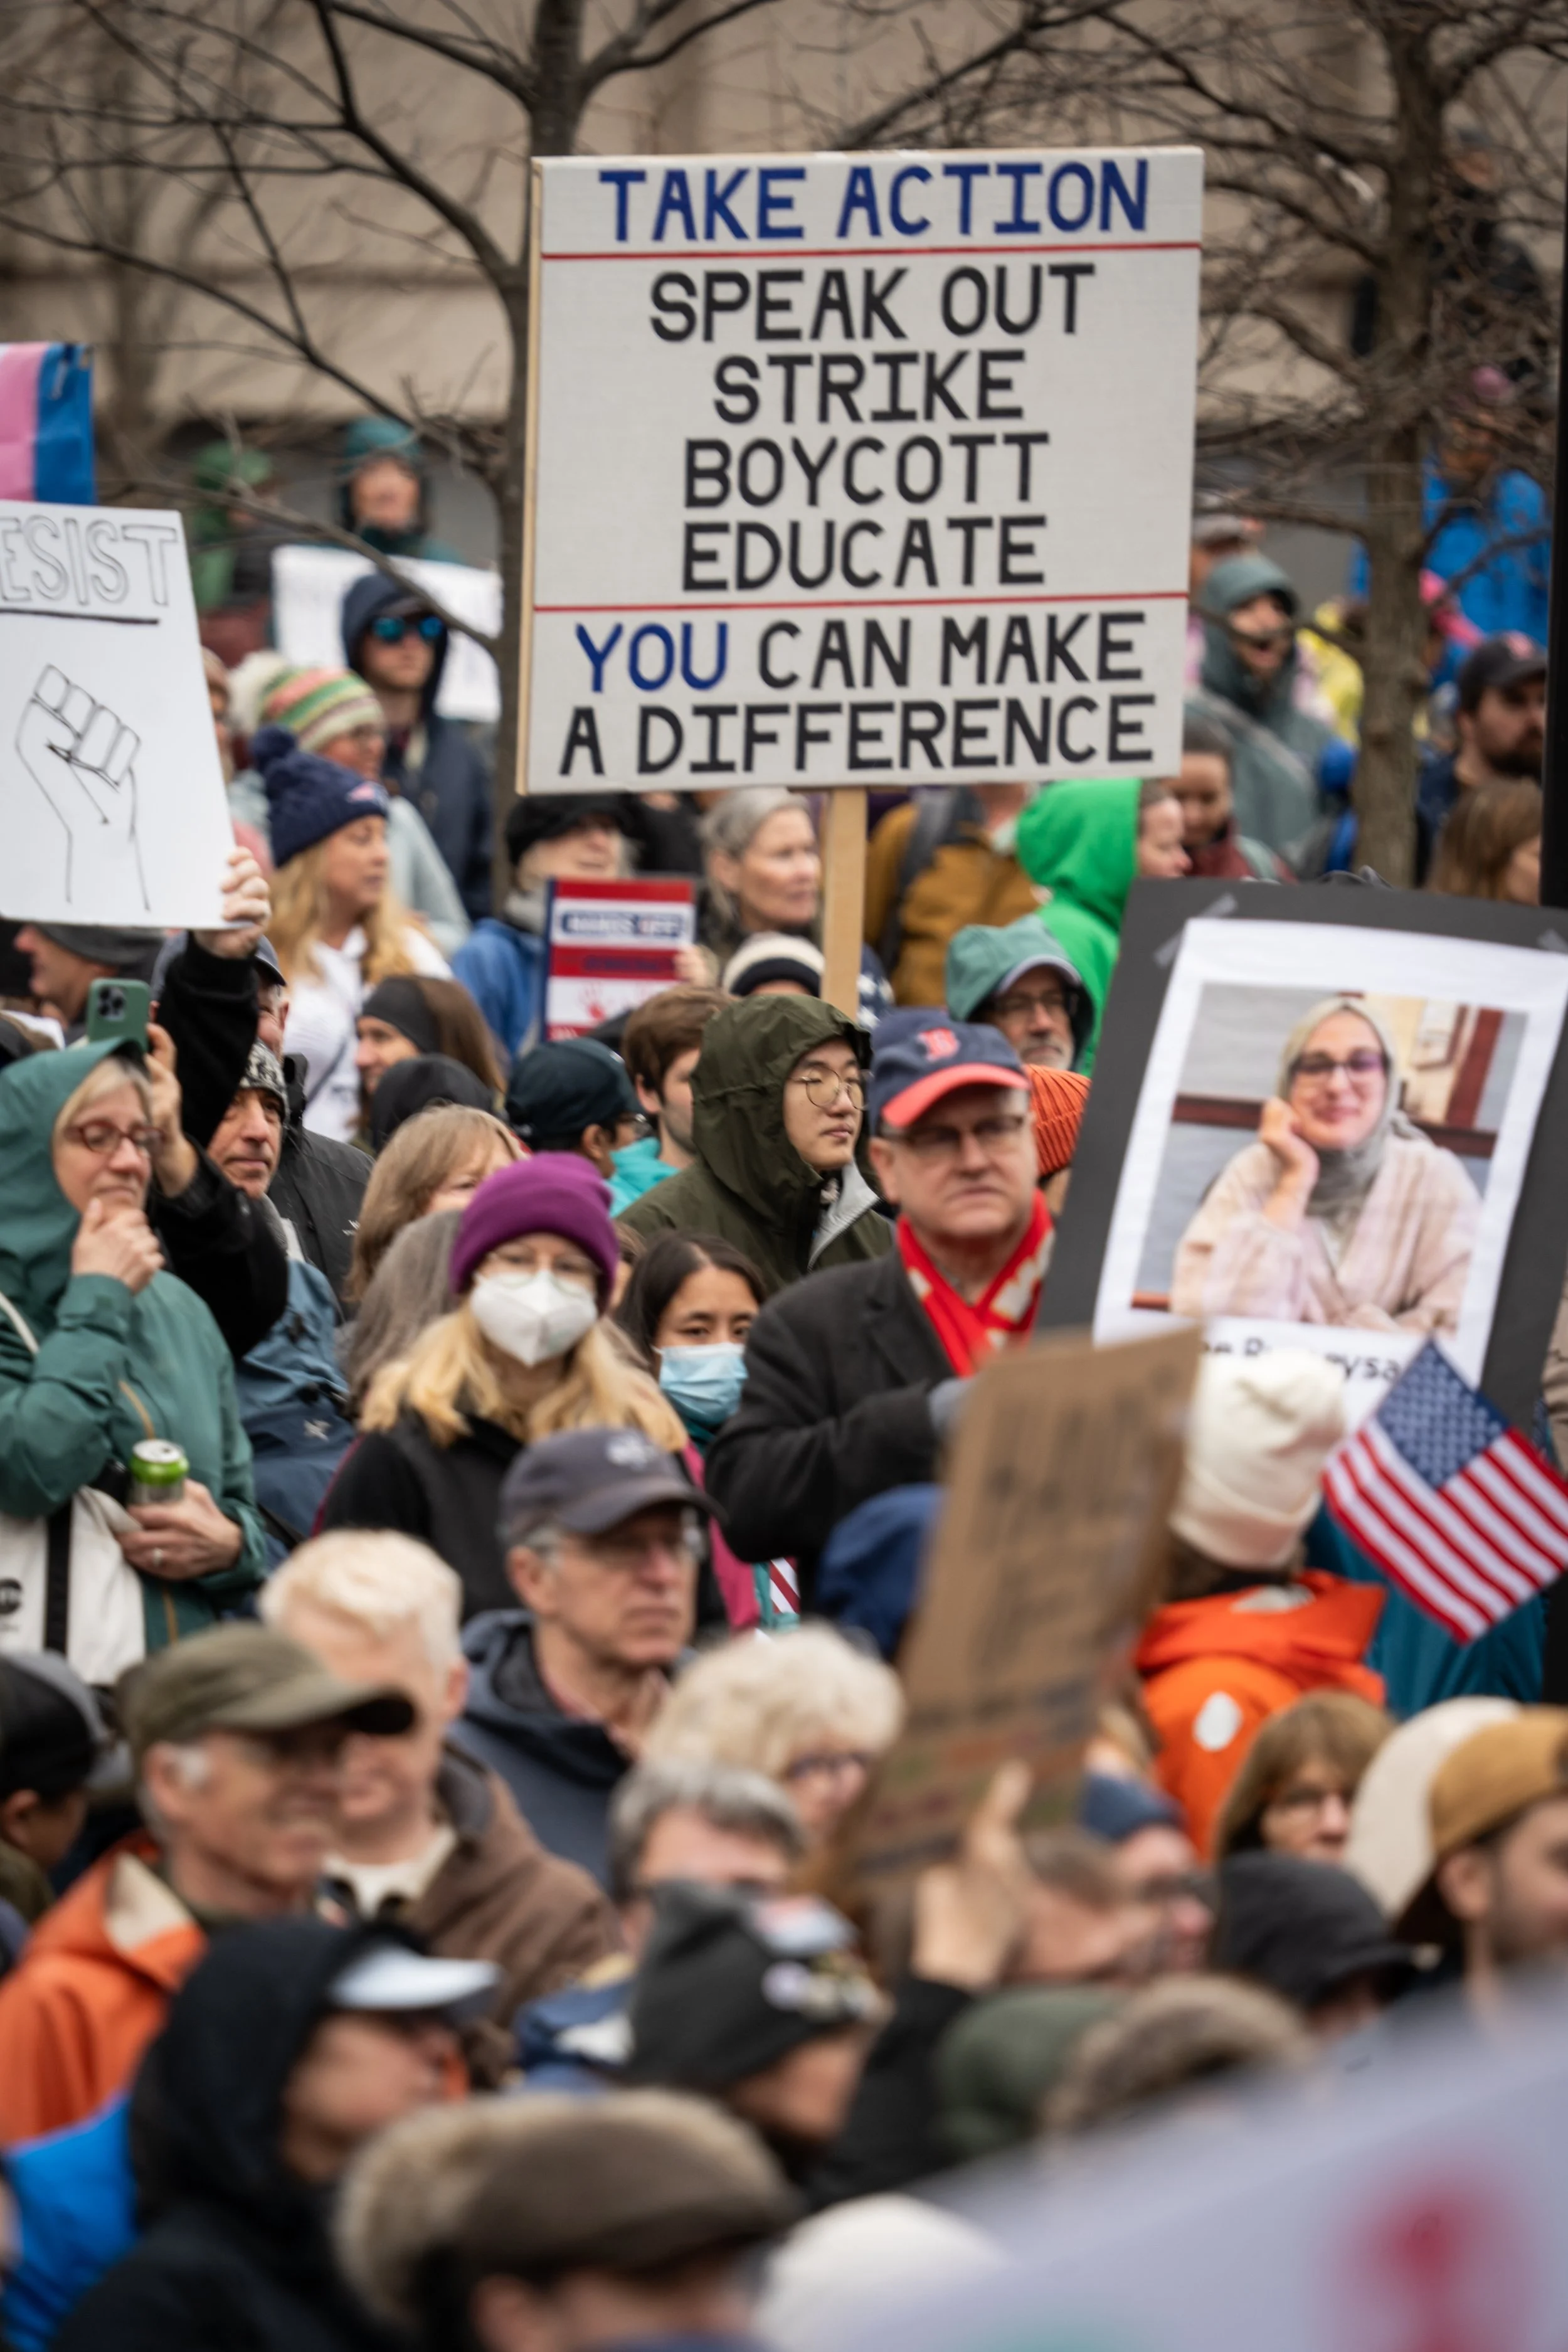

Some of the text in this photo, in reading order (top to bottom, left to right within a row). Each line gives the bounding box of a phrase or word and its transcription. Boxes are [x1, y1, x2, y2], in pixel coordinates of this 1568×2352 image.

[598, 159, 1148, 242] TAKE ACTION
[650, 262, 1096, 342] SPEAK OUT
[713, 349, 1026, 425] STRIKE
[684, 432, 1050, 509] BOYCOTT
[682, 515, 1047, 592] EDUCATE
[576, 612, 1146, 693] YOU CAN MAKE
[559, 694, 1156, 776] A DIFFERENCE
